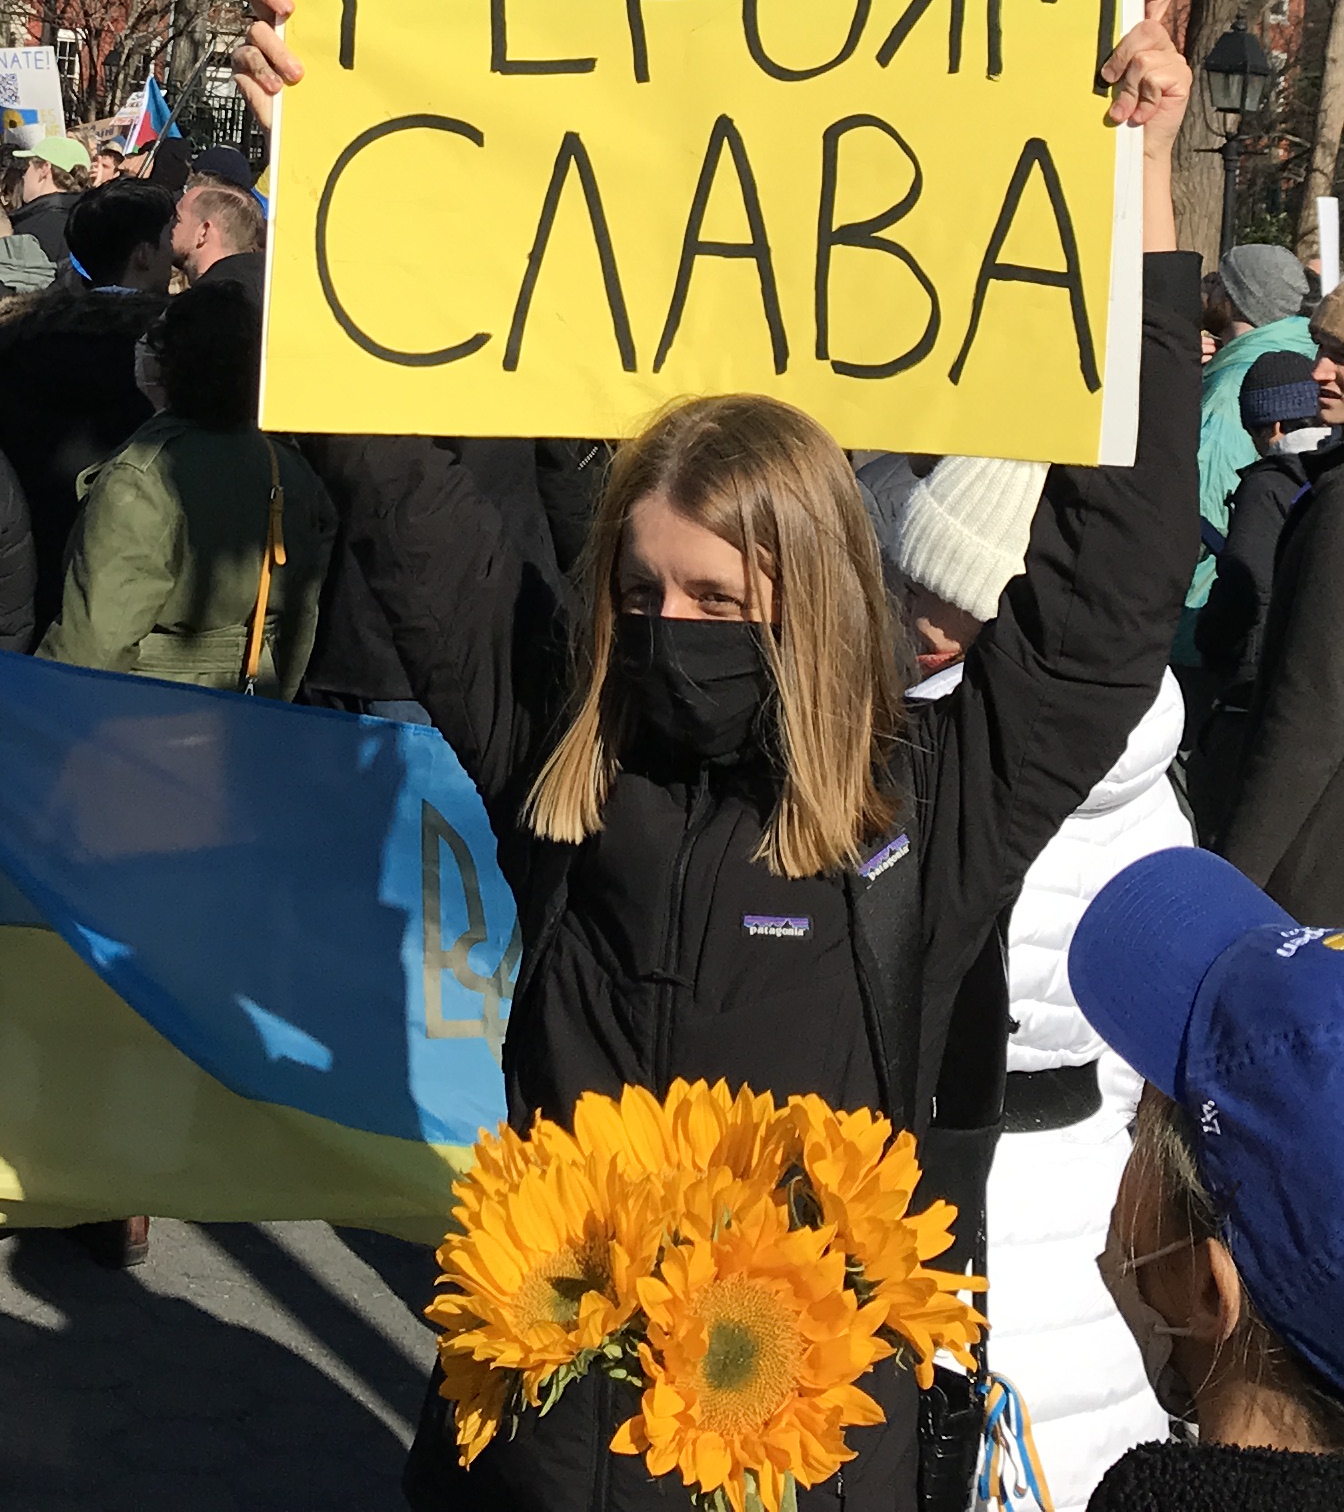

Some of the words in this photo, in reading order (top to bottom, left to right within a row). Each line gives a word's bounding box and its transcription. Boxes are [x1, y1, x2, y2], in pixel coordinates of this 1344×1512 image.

[316, 115, 1102, 394] СЛАВА
[867, 842, 910, 883] patagonia
[748, 924, 806, 938] patagonia
